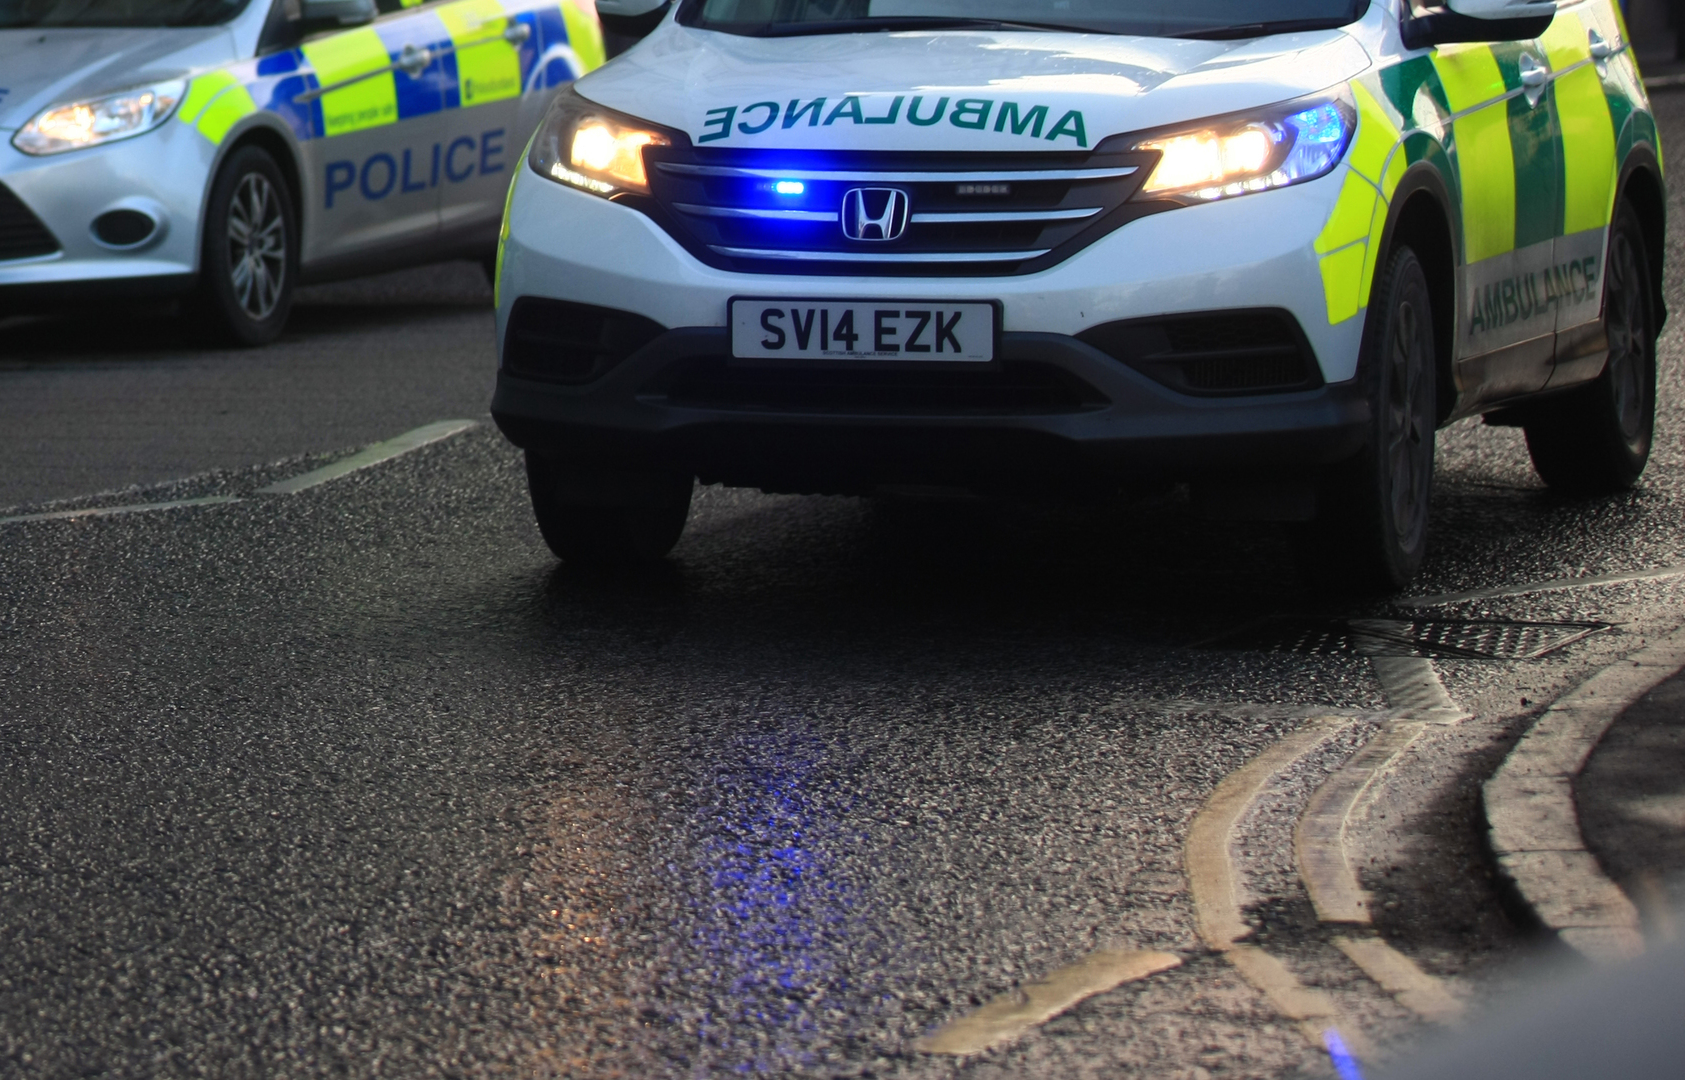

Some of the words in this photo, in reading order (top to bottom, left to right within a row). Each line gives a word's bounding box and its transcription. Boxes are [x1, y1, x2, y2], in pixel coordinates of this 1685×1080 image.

[324, 127, 506, 210] POLICE
[760, 308, 859, 351] SV14
[874, 310, 963, 353] EZK
[1469, 256, 1596, 336] AMBULANCE
